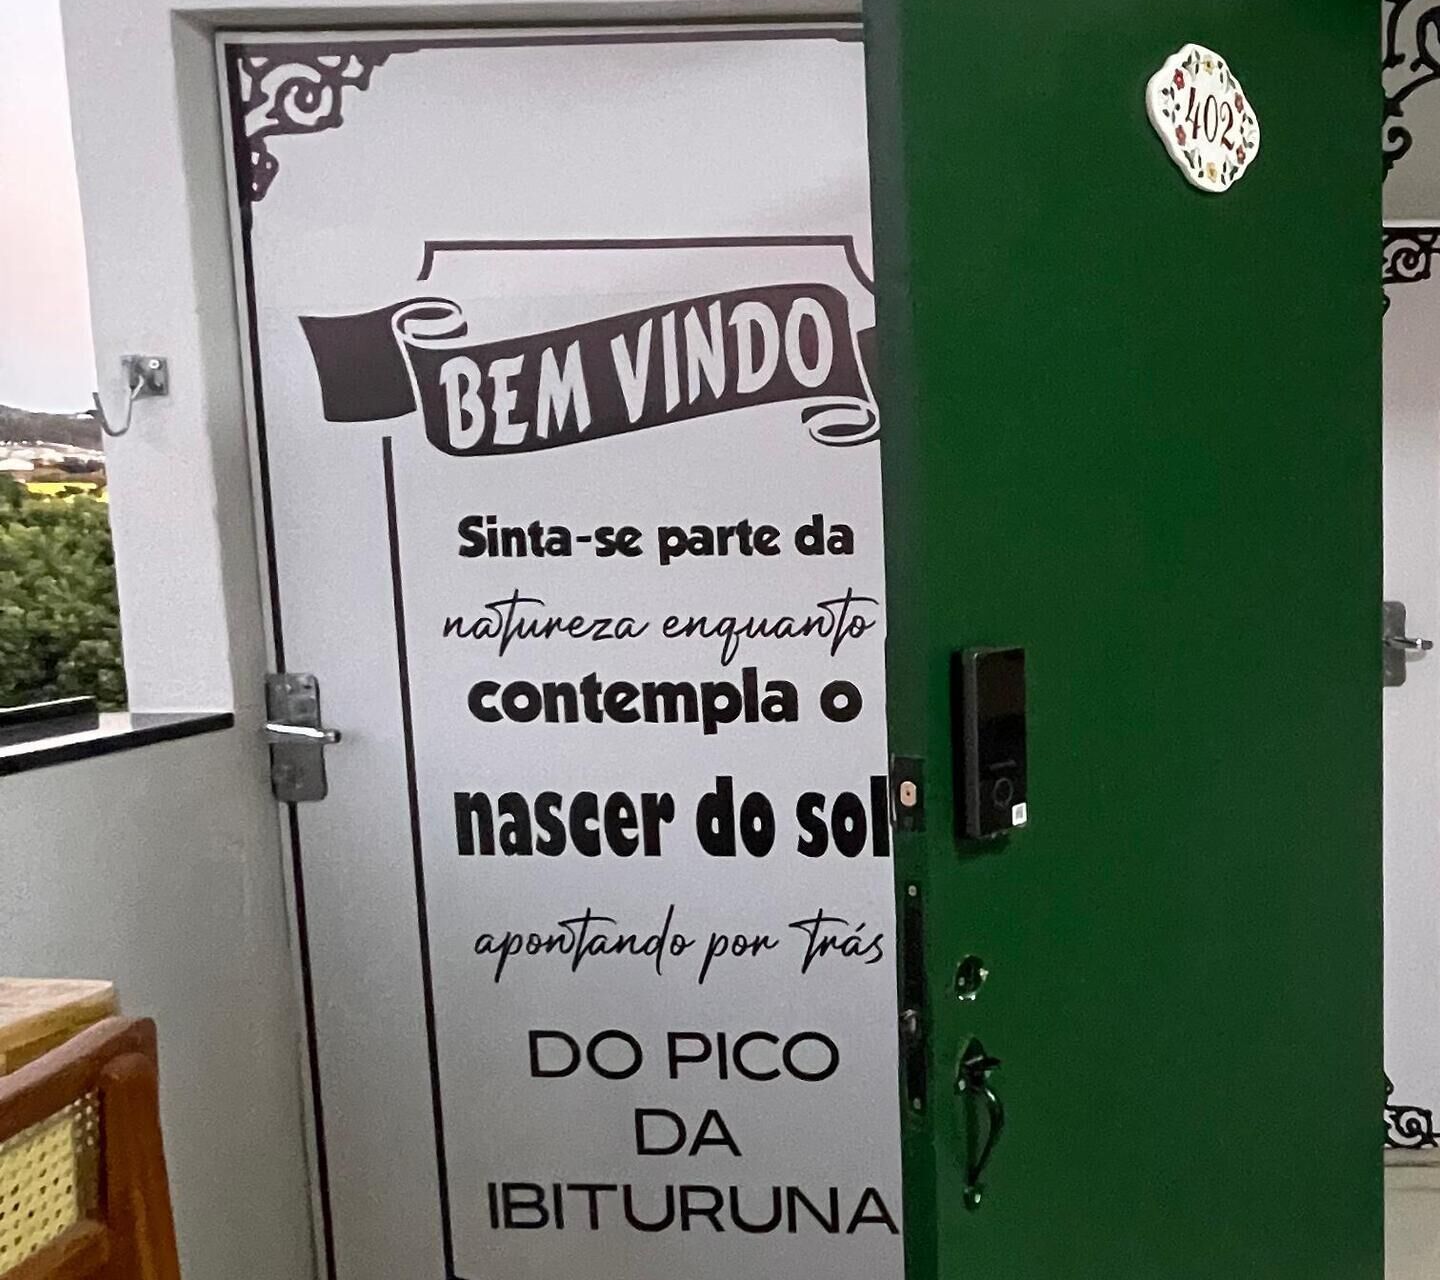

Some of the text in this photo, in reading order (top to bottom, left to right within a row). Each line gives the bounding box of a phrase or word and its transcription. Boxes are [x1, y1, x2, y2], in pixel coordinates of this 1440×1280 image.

[1185, 86, 1236, 151] 402
[438, 296, 834, 450] BEM VINDO
[457, 513, 856, 566] Sinta-se parte da
[442, 587, 880, 667] natureza enquanto
[467, 666, 864, 736] contempla o
[453, 775, 891, 858] nascer do sol
[474, 903, 886, 986] apontando por trás
[527, 1029, 842, 1083] DO PICO
[633, 1107, 744, 1158] DA
[486, 1182, 900, 1236] IBITURUNA
